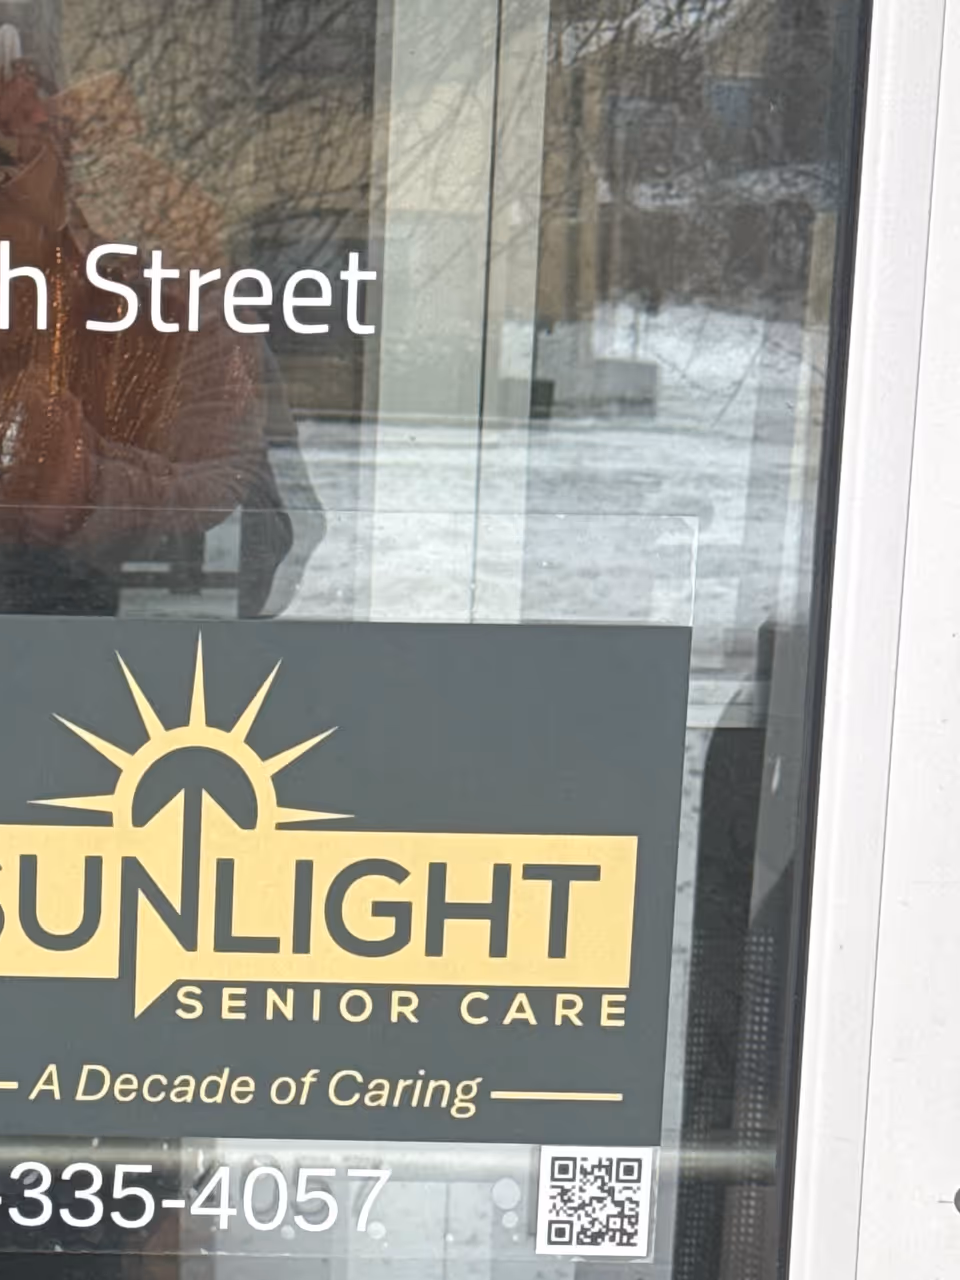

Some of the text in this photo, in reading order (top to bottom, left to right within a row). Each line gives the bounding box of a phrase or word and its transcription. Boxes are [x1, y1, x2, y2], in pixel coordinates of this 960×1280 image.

[84, 243, 378, 335] Street
[175, 986, 628, 1028] SENIOR CARE
[29, 1063, 483, 1119] A Decade of Caring
